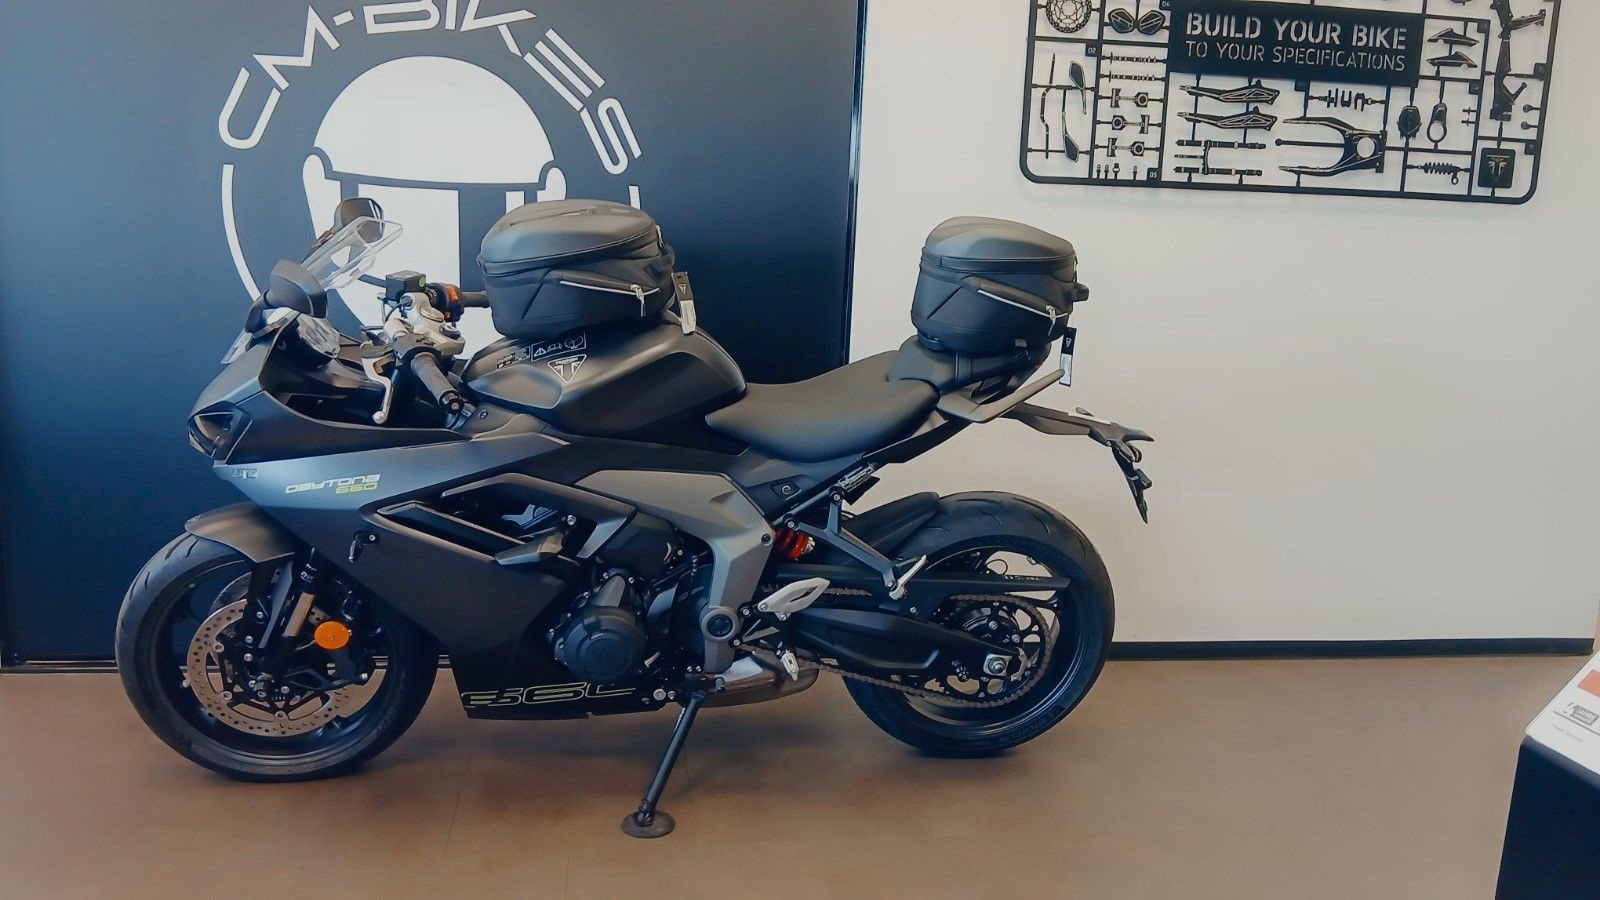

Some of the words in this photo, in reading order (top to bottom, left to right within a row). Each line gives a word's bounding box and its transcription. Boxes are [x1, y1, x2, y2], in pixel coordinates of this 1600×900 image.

[1186, 12, 1261, 39] BUILD
[1274, 17, 1341, 45] YOUR
[1352, 24, 1407, 50] BIKE
[1185, 40, 1208, 58] TO
[1216, 42, 1264, 62] YOUR
[1272, 46, 1405, 72] SPECIFICATIONS
[285, 474, 380, 494] DAYTONA
[335, 482, 378, 494] 660
